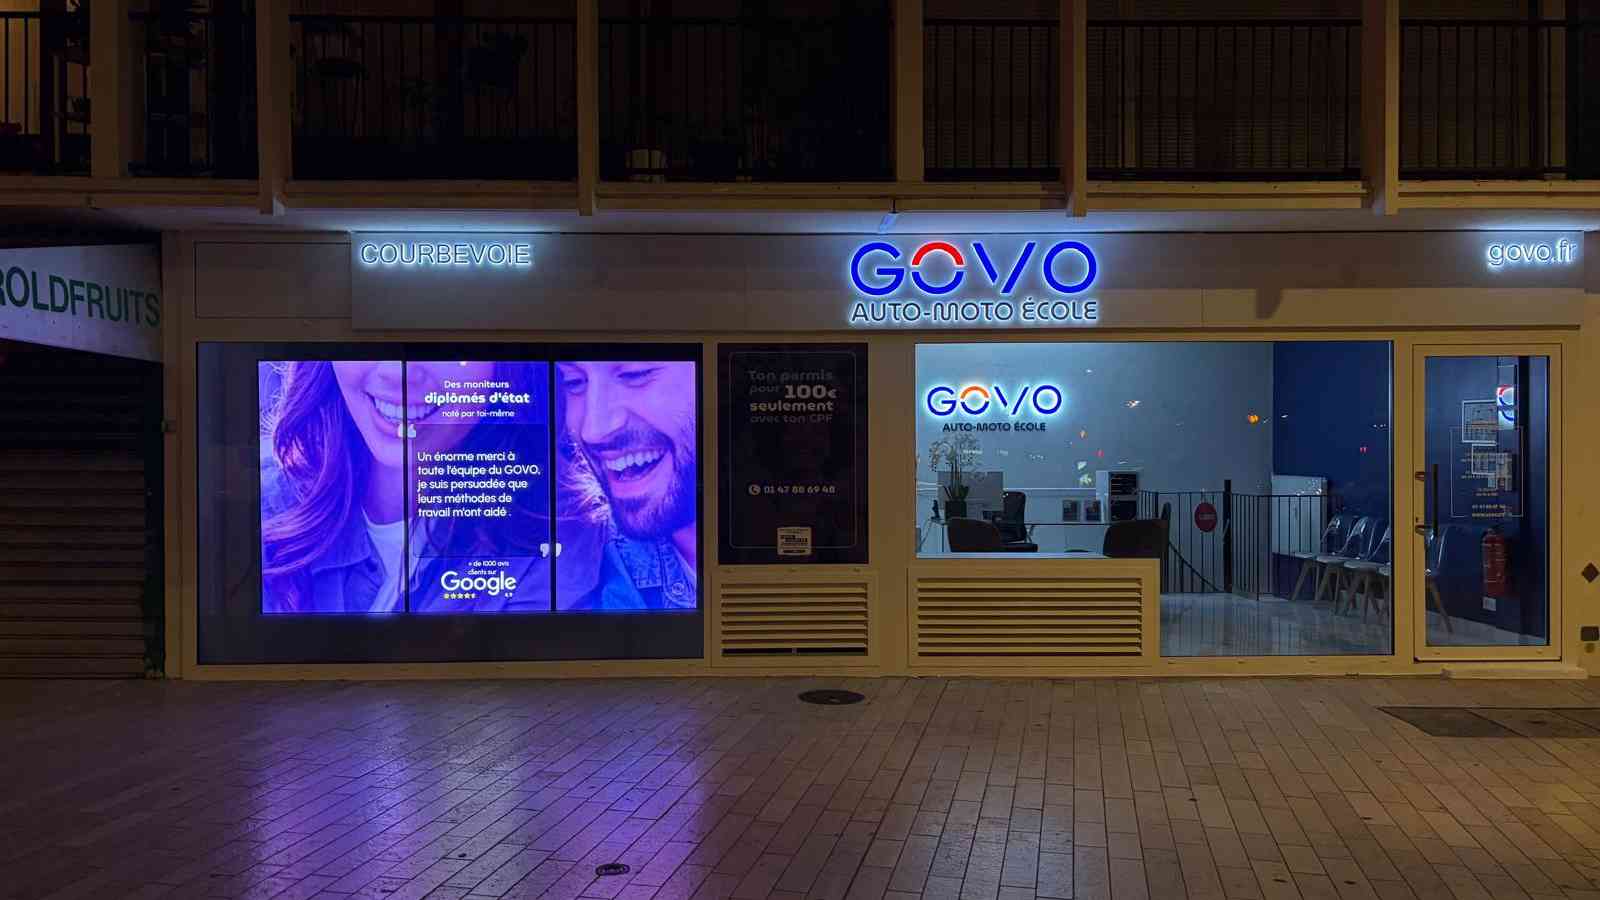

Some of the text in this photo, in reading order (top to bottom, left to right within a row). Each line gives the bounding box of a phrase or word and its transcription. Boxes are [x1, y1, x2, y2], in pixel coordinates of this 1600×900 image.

[361, 243, 529, 264] COURBEVOIE
[1489, 239, 1577, 266] govo.fr
[850, 241, 1097, 296] GOVO
[851, 297, 1097, 322] AUTO-MOTO ÉCOLE
[748, 369, 833, 384] Ton permis
[444, 380, 509, 389] Des moniteurs
[750, 384, 837, 399] pour 100€
[424, 392, 530, 406] diplômés d'état
[750, 400, 834, 412] seulement
[927, 384, 1062, 416] GOVO
[442, 409, 516, 420] noté par toi-même
[750, 414, 833, 424] avec ton CPF
[942, 421, 1047, 433] AUTO-MOTO ÉCOLE
[417, 451, 516, 462] Un énorme merci à
[417, 464, 541, 478] toute l'équipe du GOVO,
[417, 478, 529, 493] je suis persuadée que
[763, 485, 776, 494] 01
[417, 493, 513, 504] leurs méthodes de
[418, 507, 507, 518] travail m'ont aidé
[441, 571, 517, 596] Google
